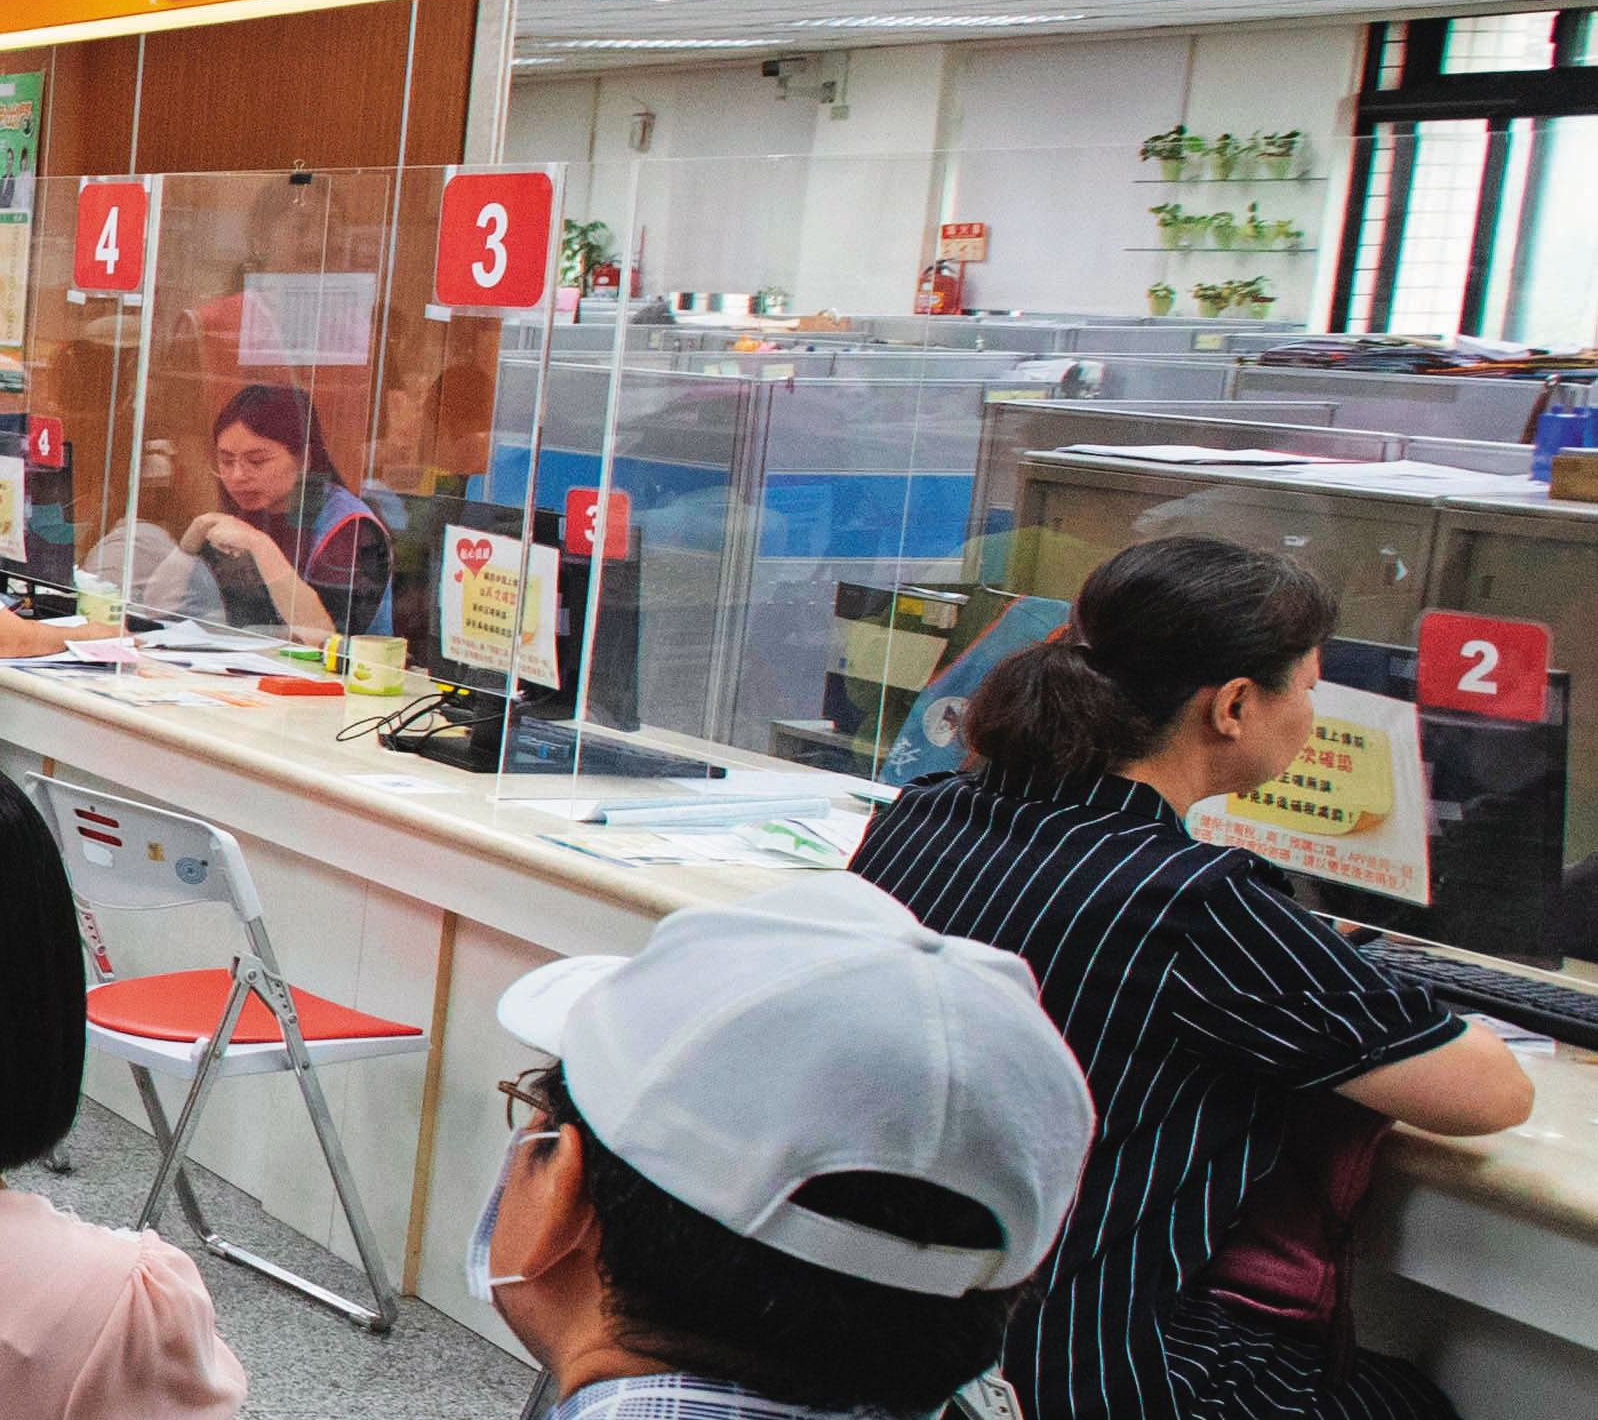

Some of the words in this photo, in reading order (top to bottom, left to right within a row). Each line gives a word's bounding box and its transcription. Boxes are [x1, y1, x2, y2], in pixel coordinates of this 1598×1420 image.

[94, 201, 120, 275] 4
[470, 202, 508, 289] 3
[38, 428, 50, 456] 4
[1456, 640, 1499, 695] 2
